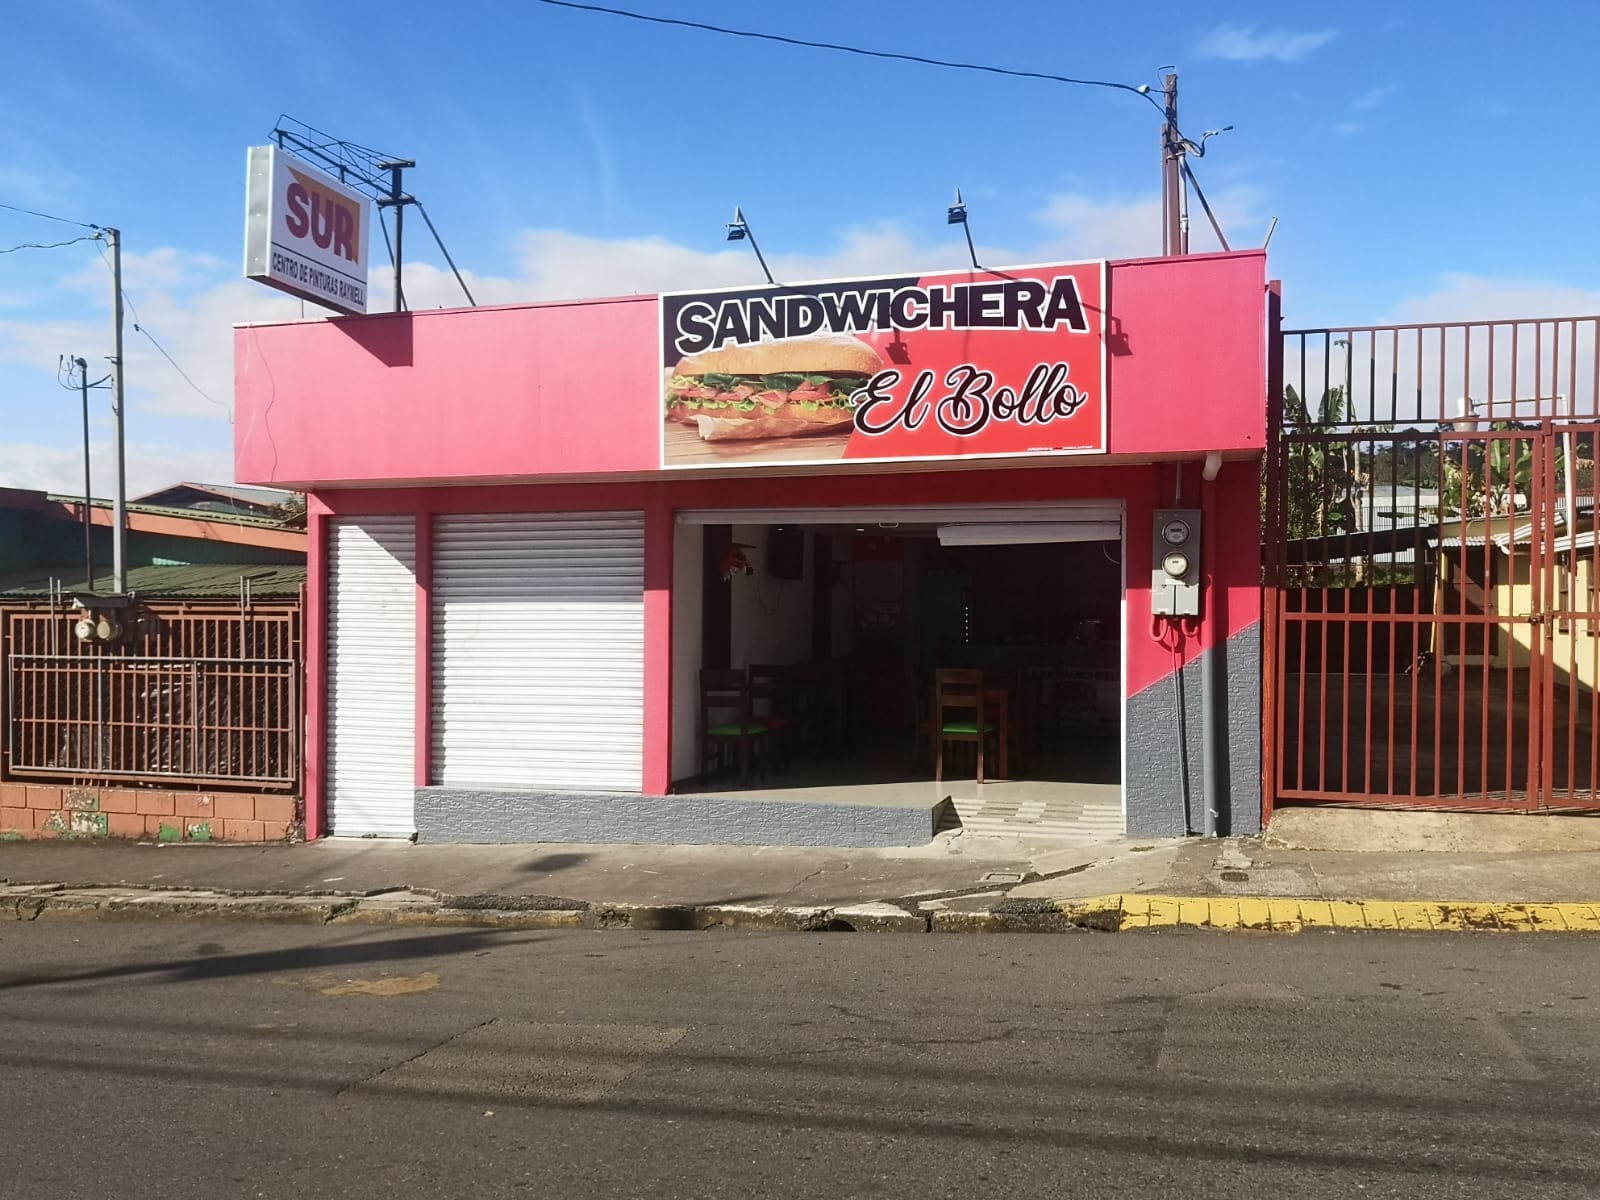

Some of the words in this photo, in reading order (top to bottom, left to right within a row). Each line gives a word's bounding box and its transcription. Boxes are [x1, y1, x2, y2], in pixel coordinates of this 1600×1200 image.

[285, 182, 354, 262] SUR
[272, 252, 297, 278] CENTRO
[299, 263, 308, 283] DE
[309, 267, 338, 295] PINTURAS
[676, 276, 1089, 355] SANDWICHERA
[850, 367, 934, 436] El
[937, 362, 1087, 436] Bollo
